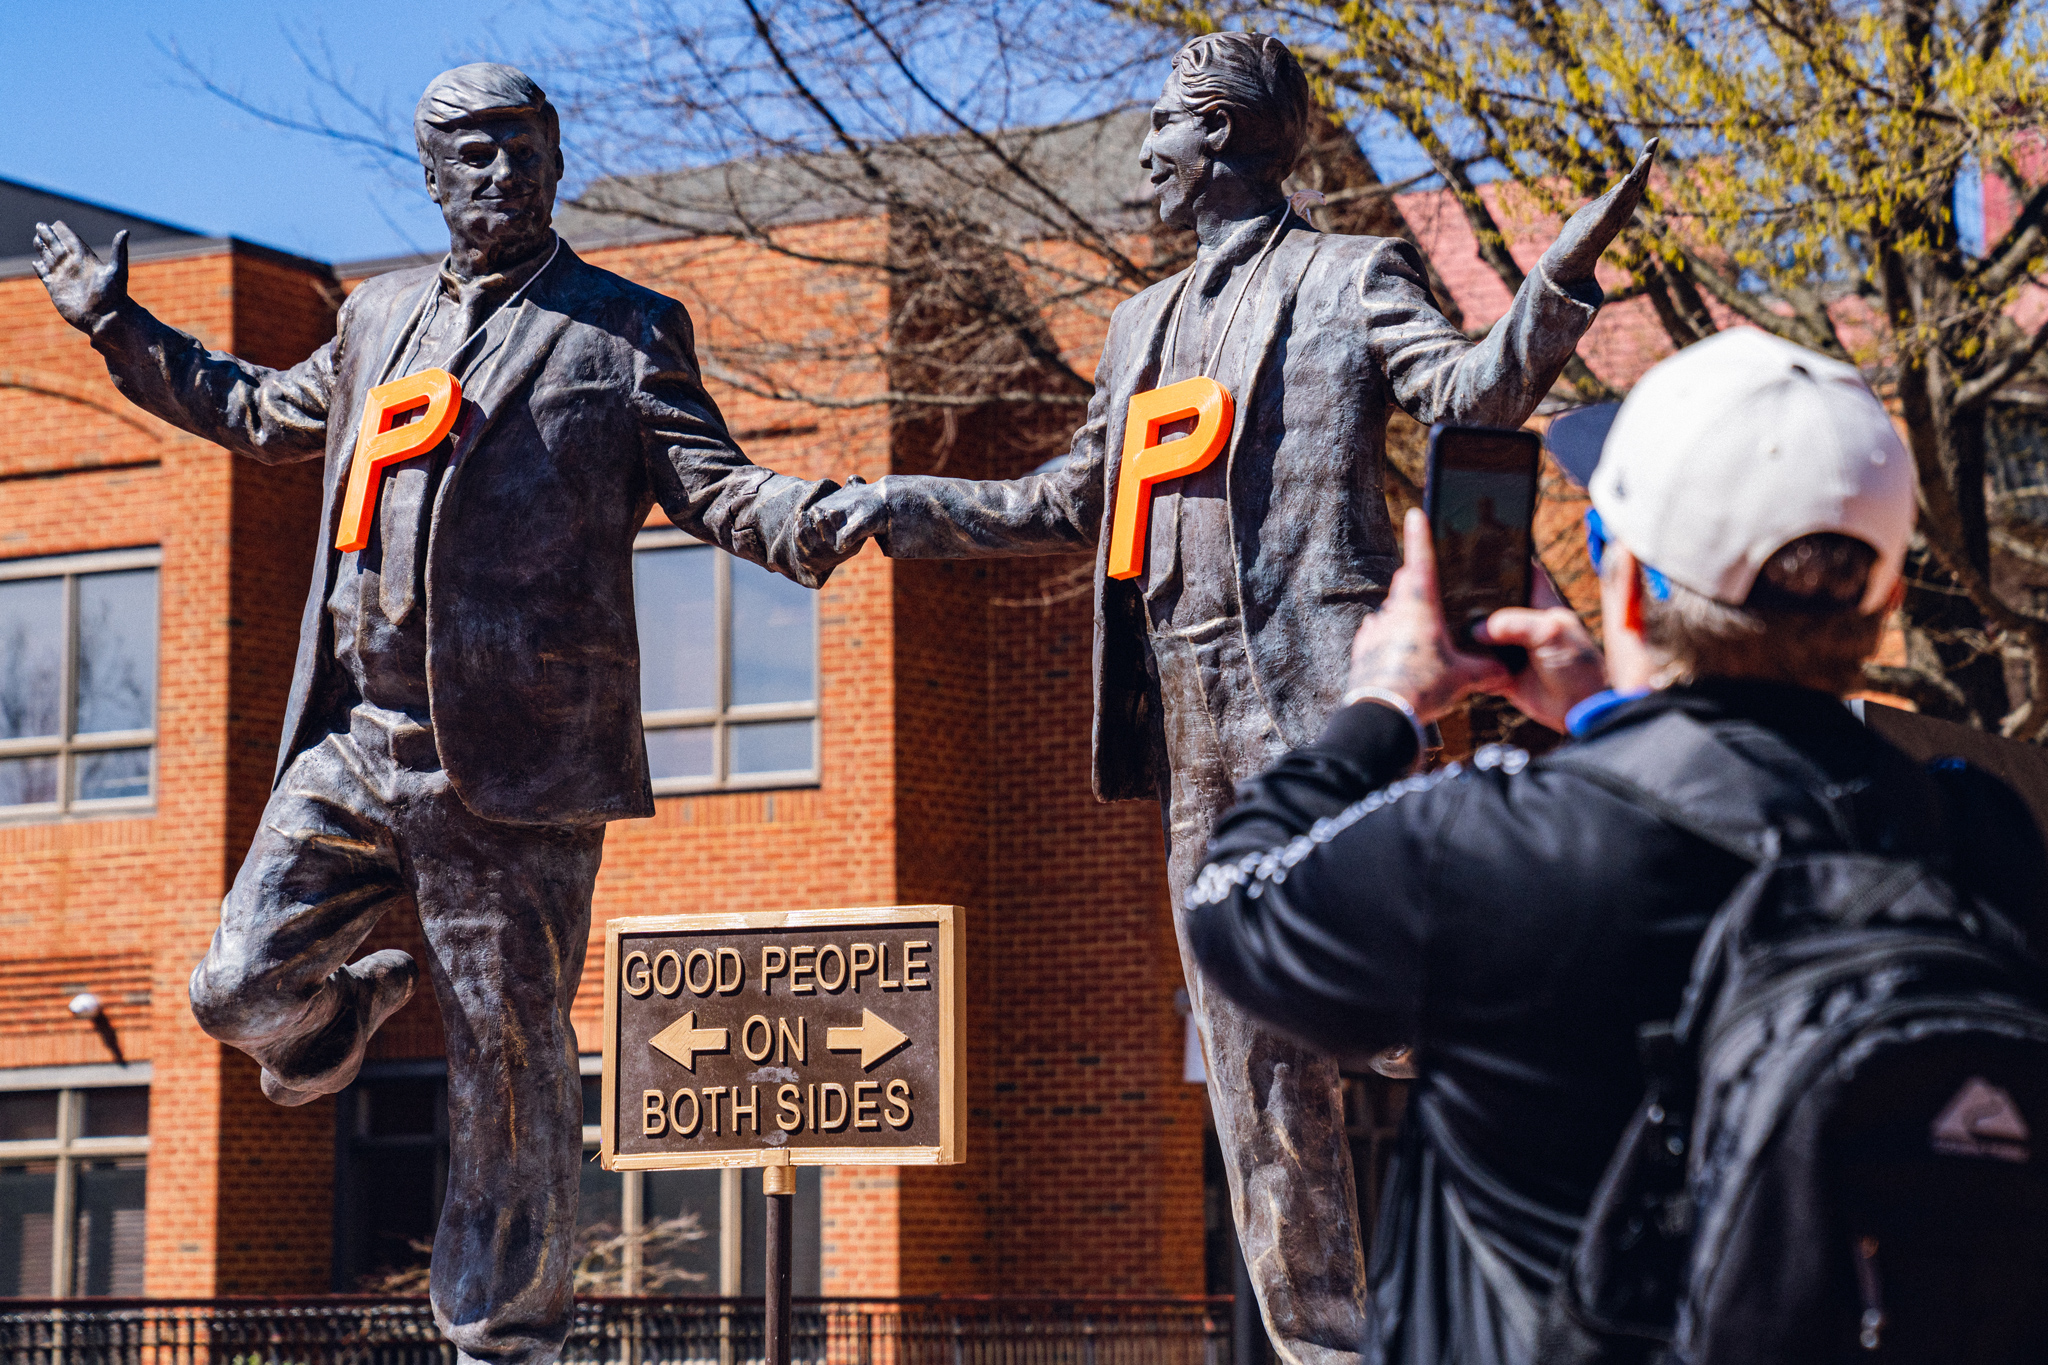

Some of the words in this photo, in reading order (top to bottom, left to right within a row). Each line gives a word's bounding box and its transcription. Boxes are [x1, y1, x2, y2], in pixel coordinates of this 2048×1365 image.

[335, 367, 462, 553] P
[1107, 375, 1234, 581] P
[622, 946, 743, 996] GOOD
[761, 940, 930, 993] PEOPLE
[741, 1014, 805, 1063] ON
[642, 1085, 758, 1136] BOTH
[775, 1078, 911, 1131] SIDES
